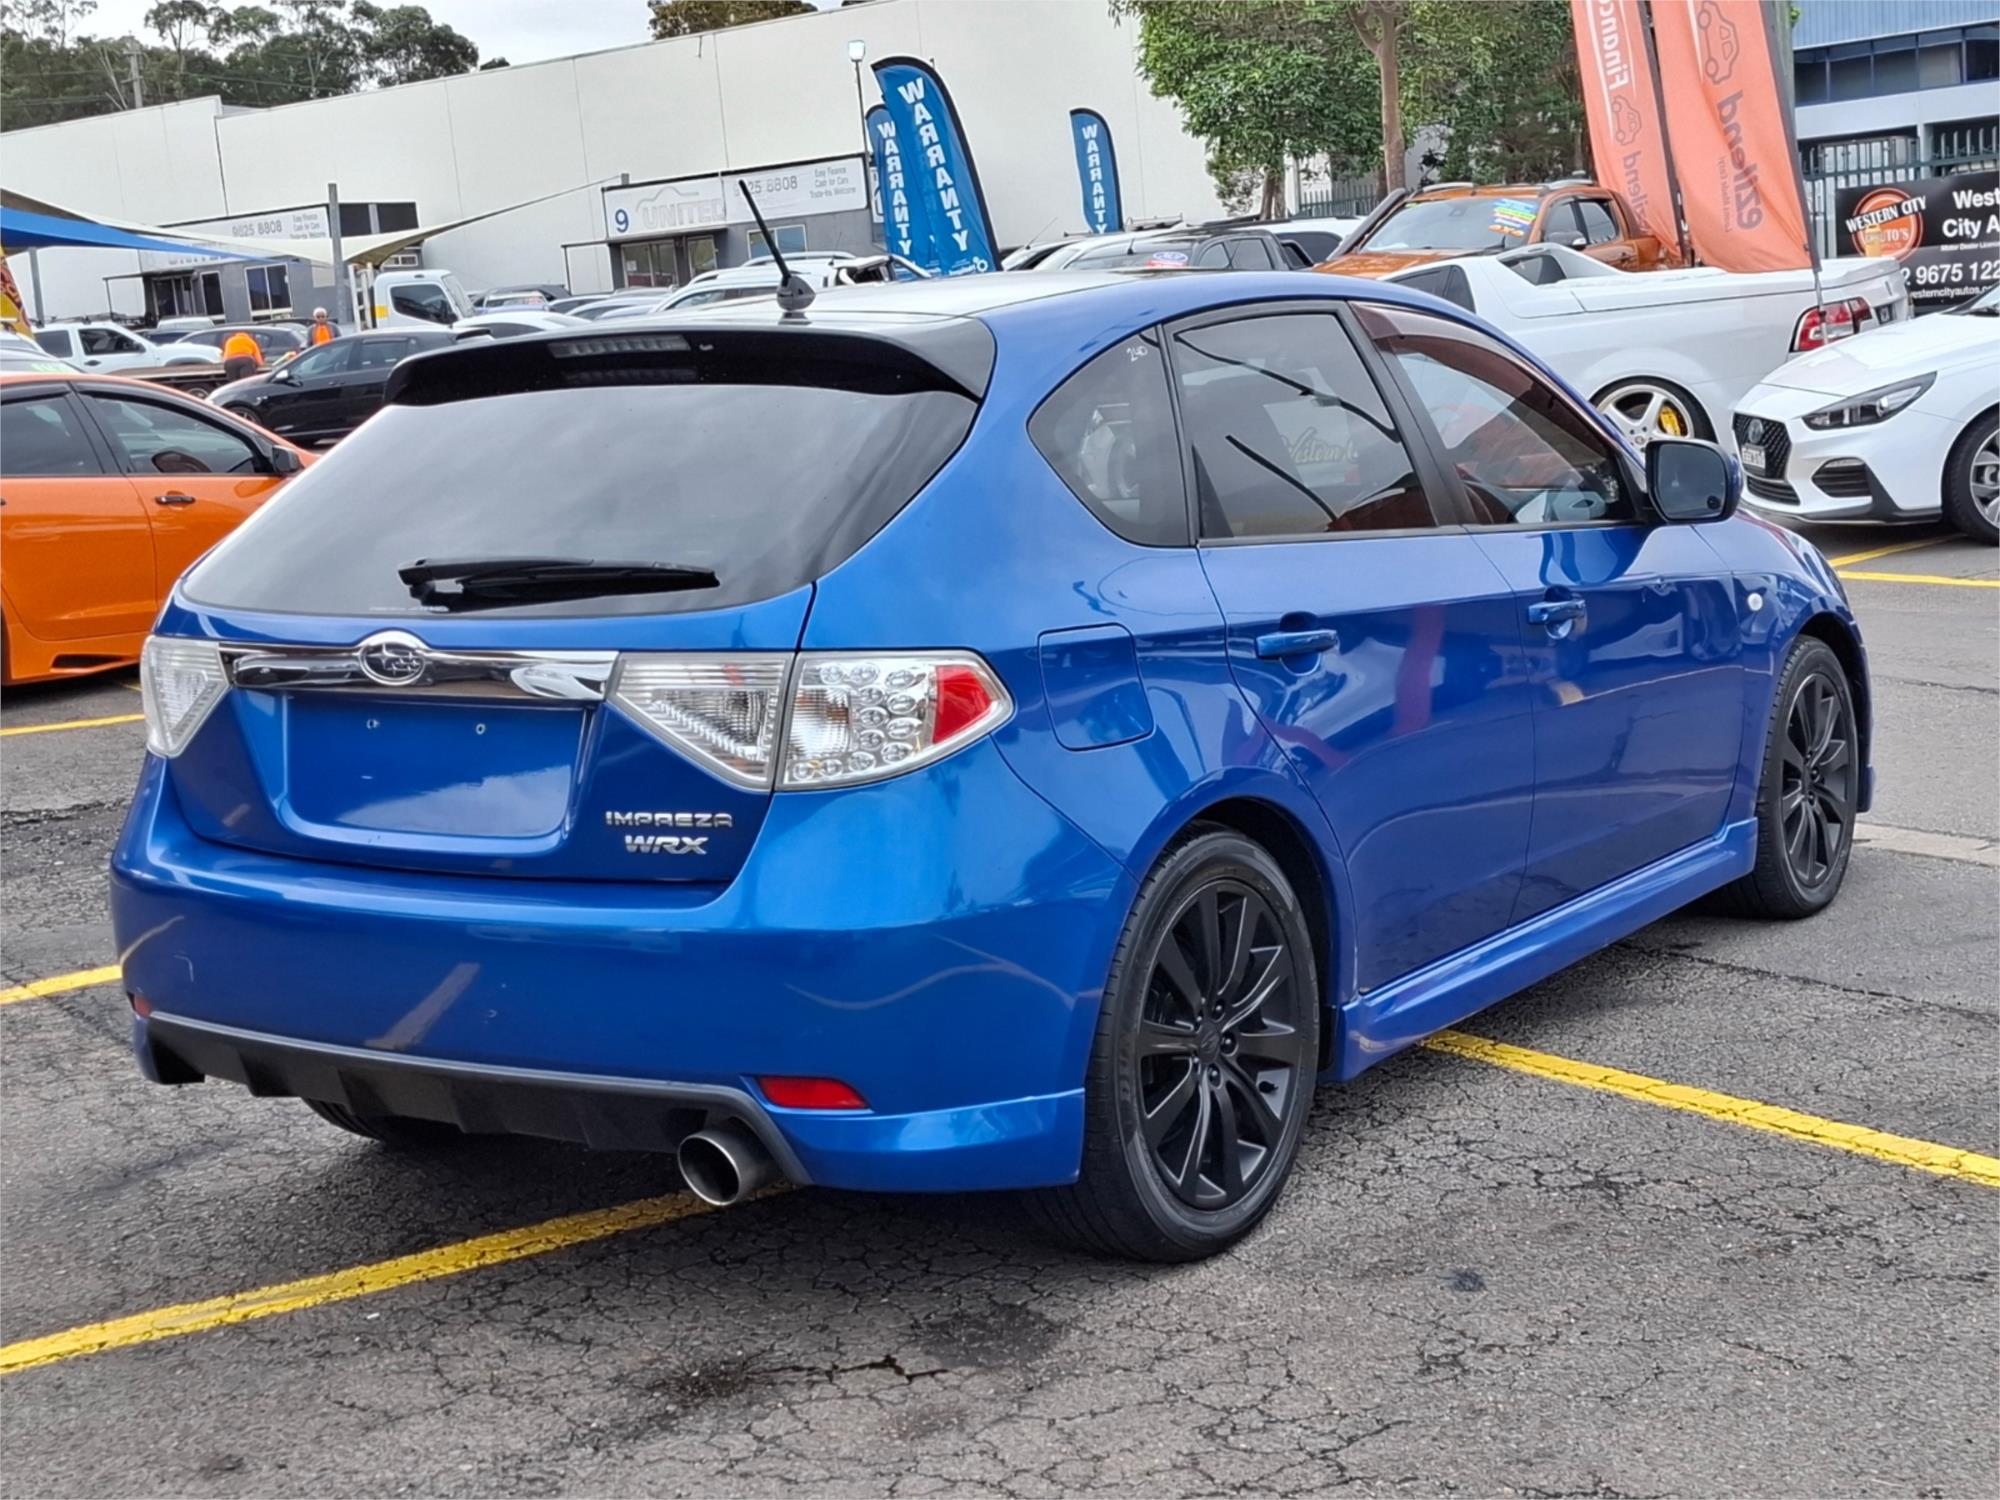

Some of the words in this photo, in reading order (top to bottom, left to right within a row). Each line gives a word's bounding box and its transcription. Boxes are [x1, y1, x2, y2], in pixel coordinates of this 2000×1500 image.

[766, 175, 798, 193] 8808
[615, 209, 629, 233] 9
[1845, 204, 1899, 234] WESTERN
[1901, 195, 1926, 215] CITY
[1942, 217, 1982, 239] City
[1916, 263, 1963, 285] 9675
[605, 811, 733, 828] IMPREZA
[624, 834, 709, 855] WRX
